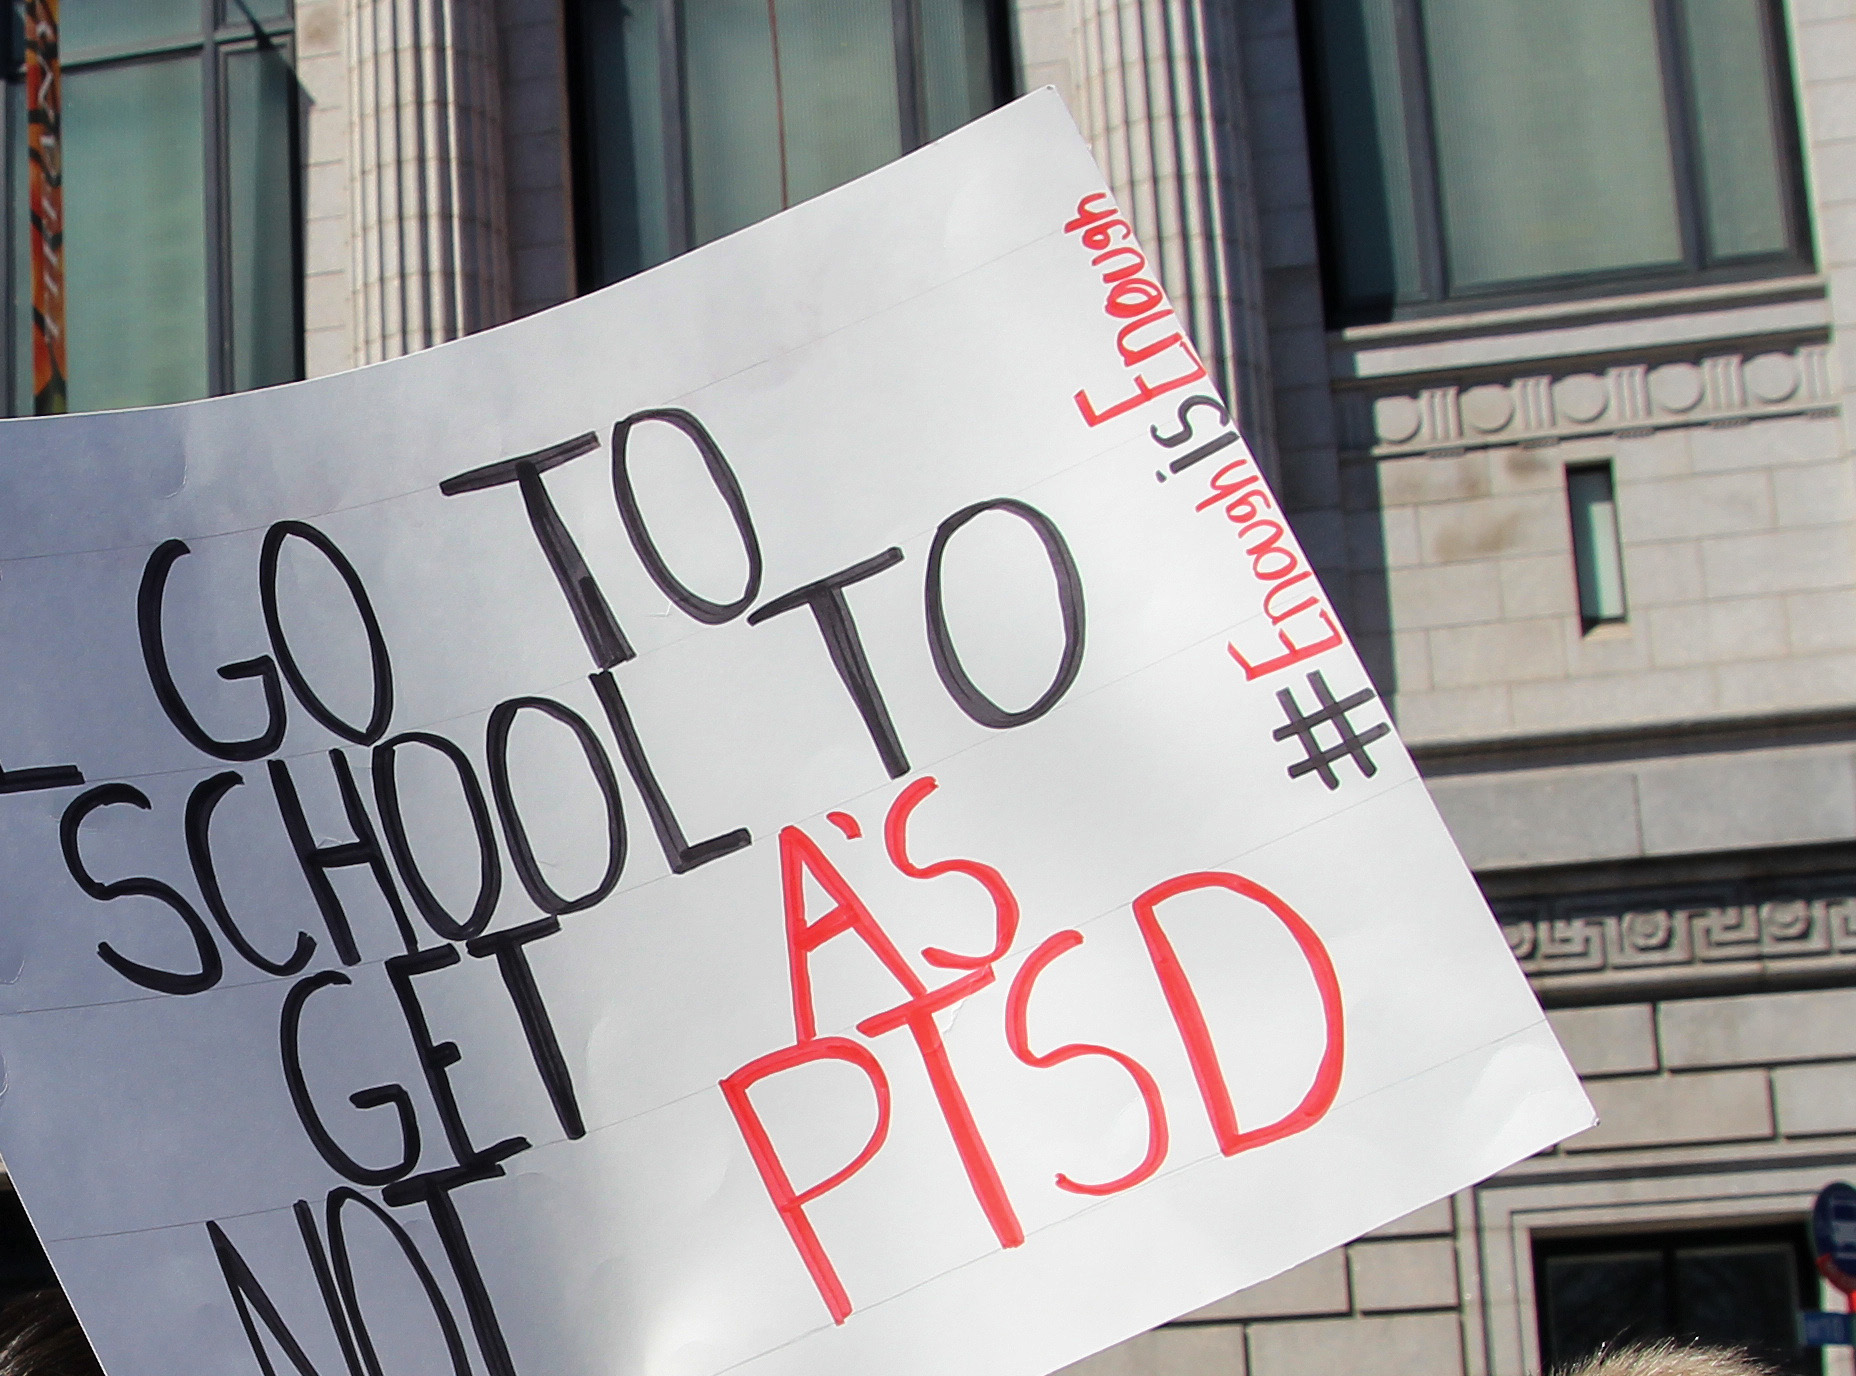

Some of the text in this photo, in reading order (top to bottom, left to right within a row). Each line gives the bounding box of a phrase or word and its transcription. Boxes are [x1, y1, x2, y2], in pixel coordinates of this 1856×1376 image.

[58, 498, 1086, 996] SCHOOL TO
[137, 520, 394, 762] GO
[439, 407, 763, 669] TO
[280, 776, 1020, 1187] GET A'S
[719, 871, 1346, 1326] PTSD
